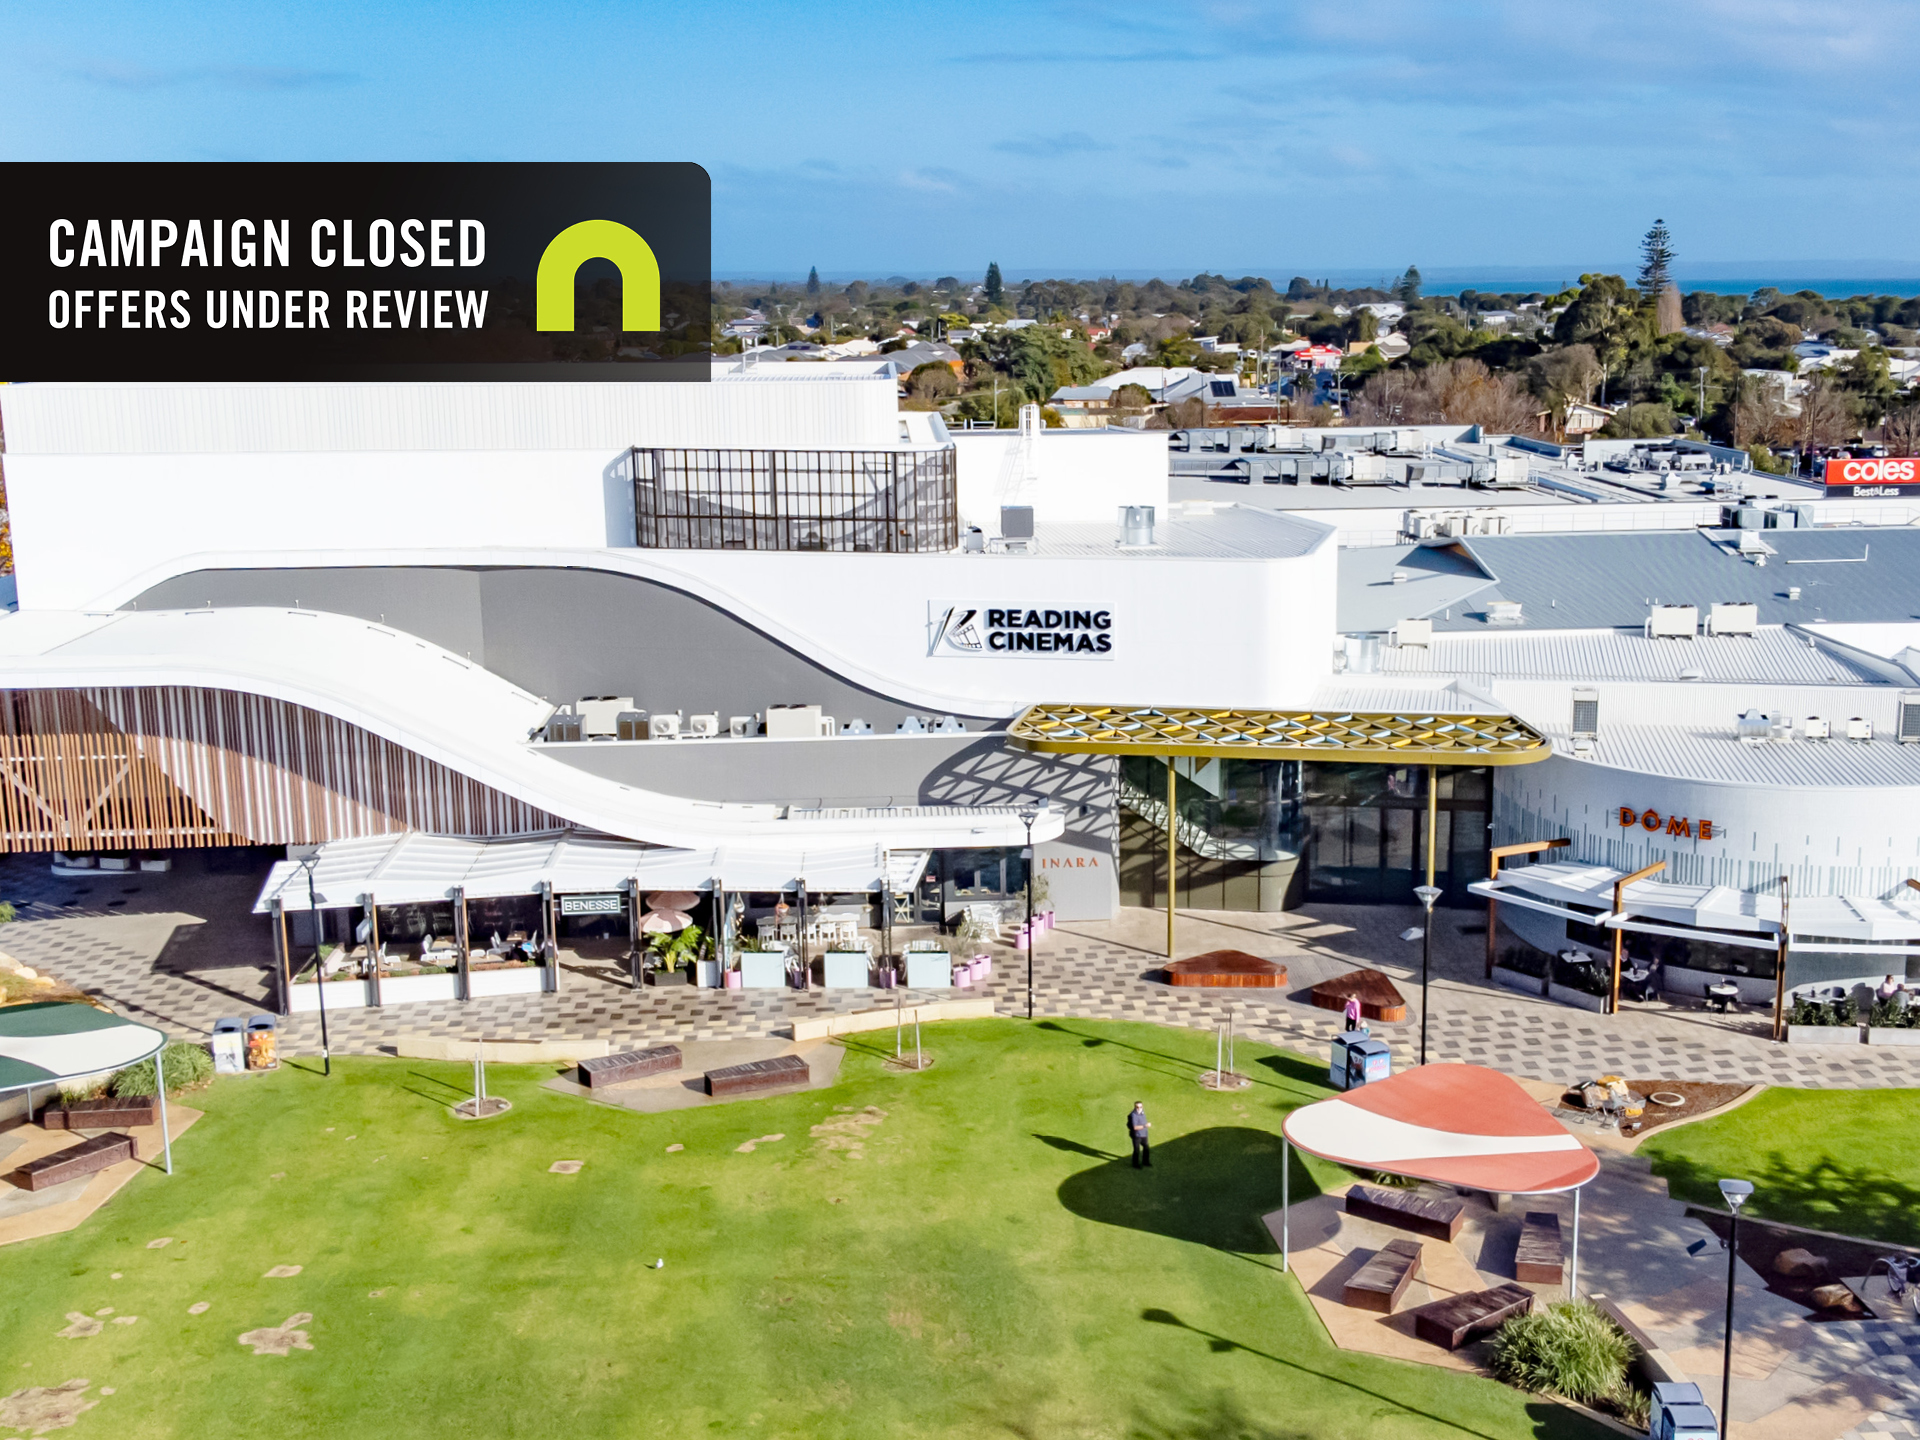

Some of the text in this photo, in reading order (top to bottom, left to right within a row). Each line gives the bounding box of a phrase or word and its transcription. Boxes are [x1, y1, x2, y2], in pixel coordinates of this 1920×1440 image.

[1843, 459, 1914, 481] coles
[987, 609, 1111, 630] READING
[987, 631, 1112, 653] CINEMAS
[1042, 857, 1098, 868] INARA
[564, 900, 618, 911] BENESSE
